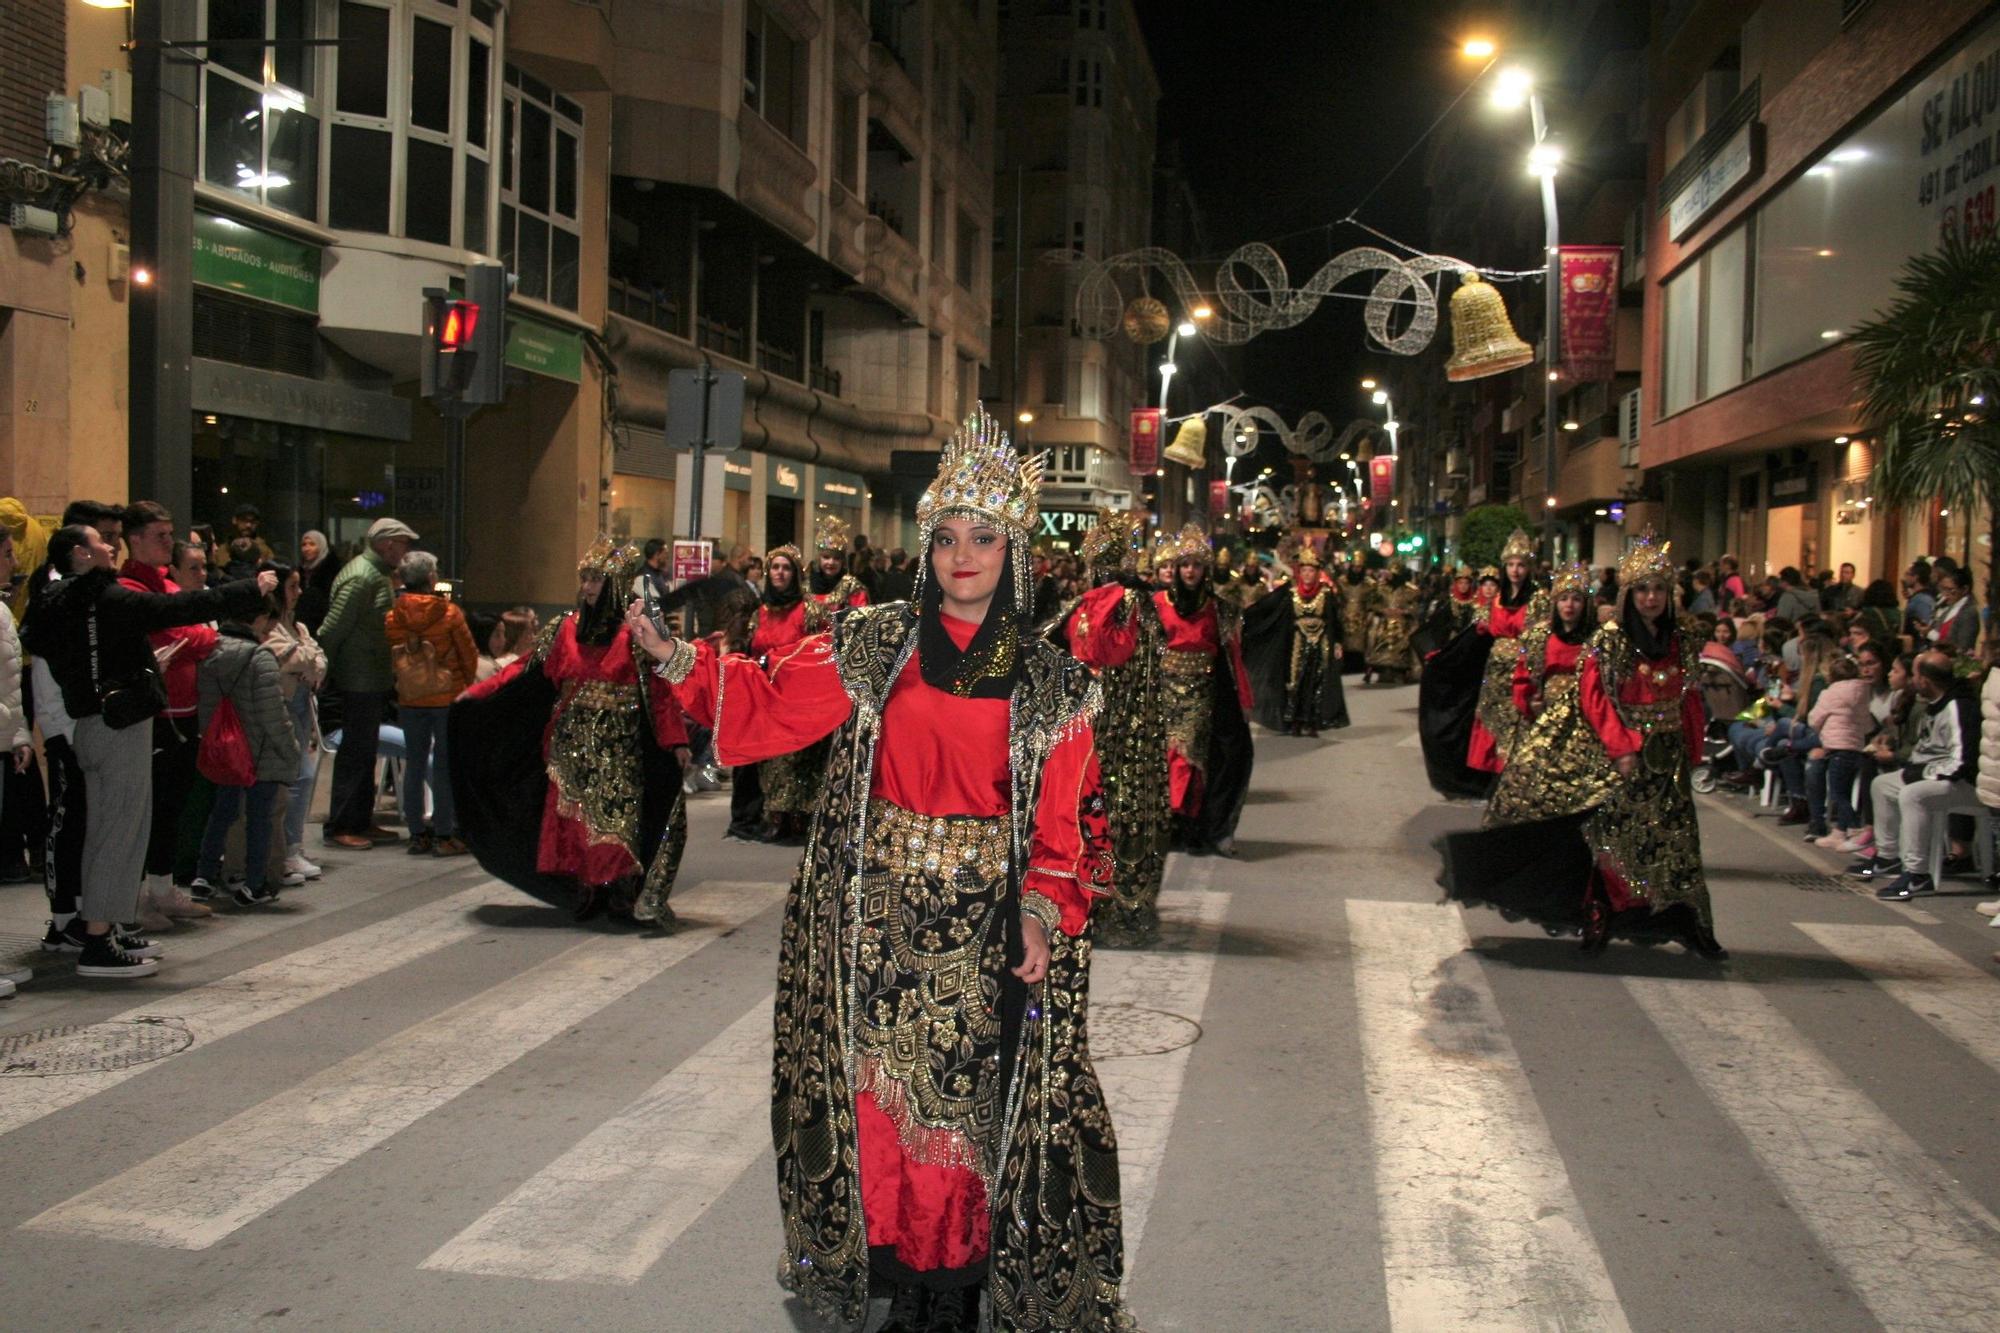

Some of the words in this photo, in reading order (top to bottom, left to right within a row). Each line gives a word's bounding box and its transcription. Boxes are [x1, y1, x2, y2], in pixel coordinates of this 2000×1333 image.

[1921, 90, 1944, 156] SE
[211, 243, 262, 268] ABOGADOS
[269, 261, 315, 283] AUDITORES
